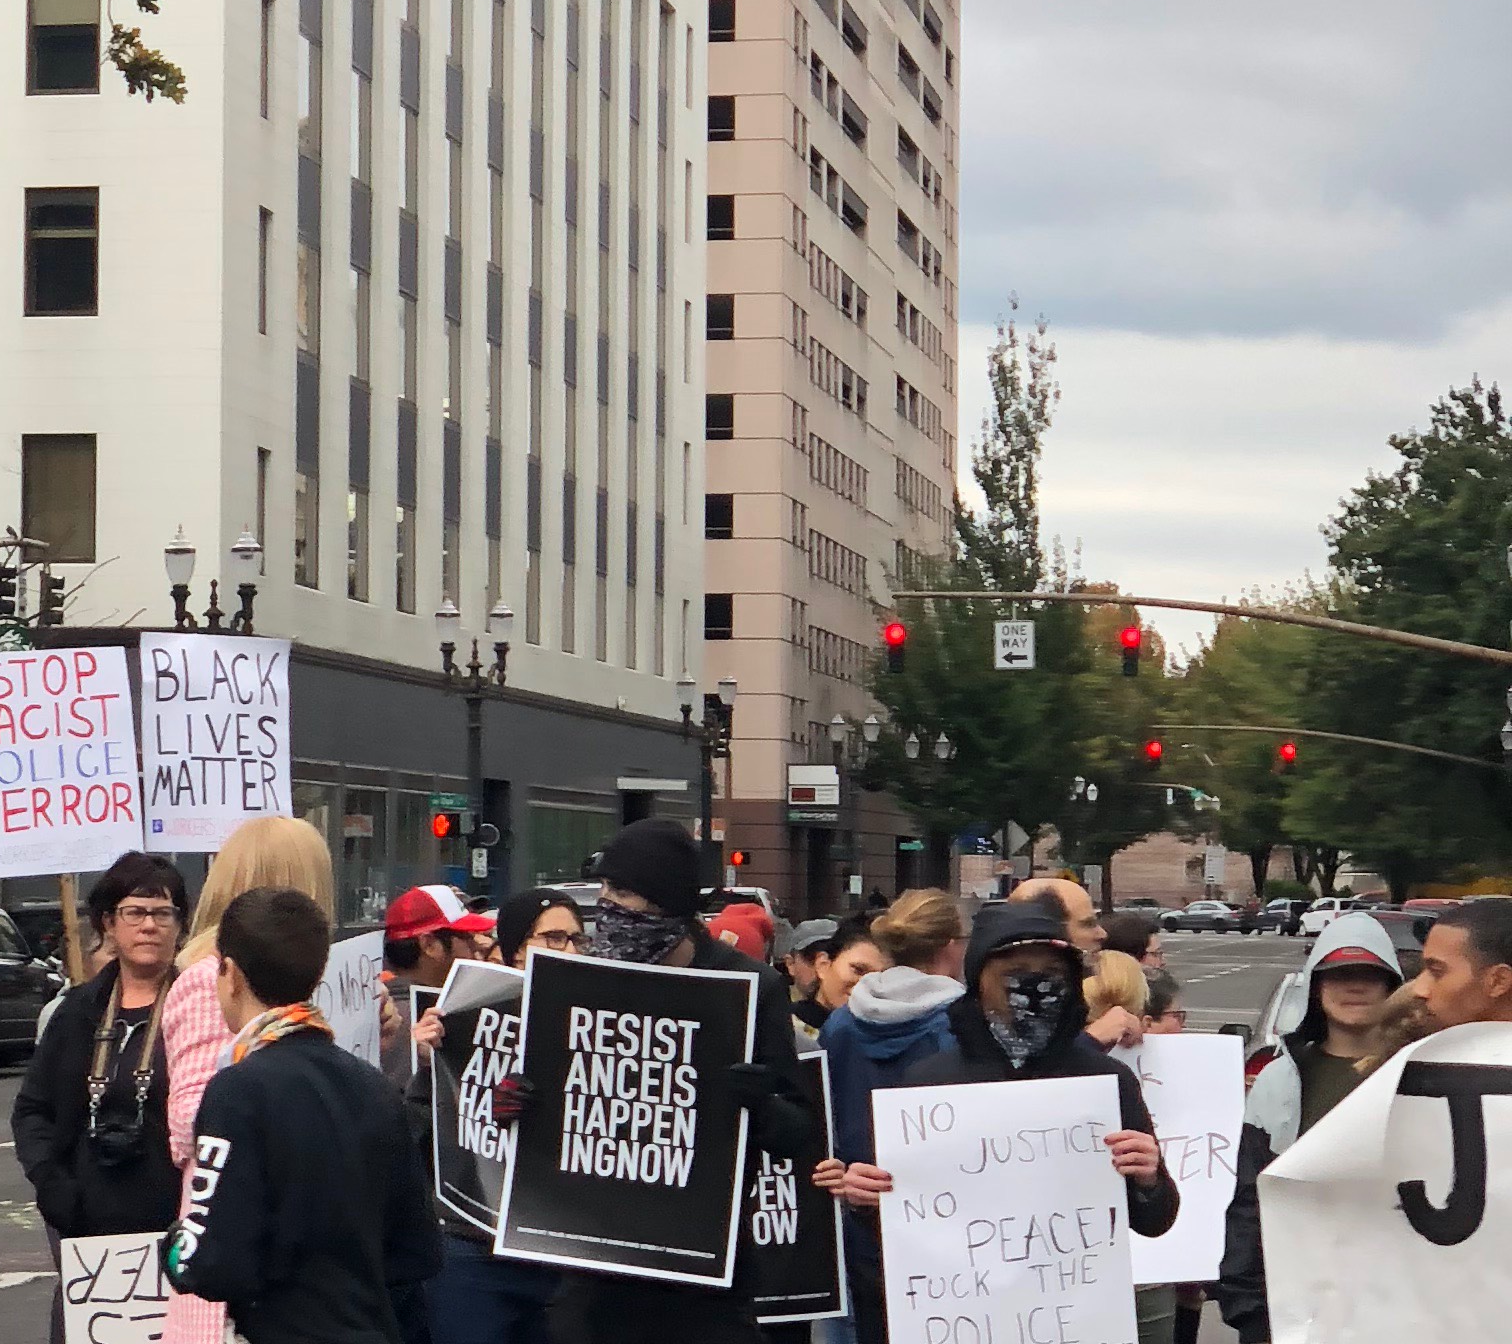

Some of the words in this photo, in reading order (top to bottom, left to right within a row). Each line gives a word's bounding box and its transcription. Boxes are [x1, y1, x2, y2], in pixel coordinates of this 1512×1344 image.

[1001, 625, 1027, 636] ONE
[1001, 638, 1028, 648] WAY
[151, 648, 280, 707] BLACK
[156, 713, 278, 758] LIVES
[151, 756, 281, 811] MATTER
[473, 1007, 521, 1054] RE
[568, 1006, 701, 1064] RESIST
[461, 1047, 521, 1087] AN
[563, 1052, 698, 1107] ANCEIS
[458, 1084, 498, 1125] HA
[563, 1092, 697, 1149] HAPPEN
[900, 1101, 955, 1145] NO
[458, 1116, 513, 1163] INGN
[559, 1132, 695, 1188] INGNOW
[959, 1121, 1107, 1175] JUSTICE
[1159, 1131, 1238, 1182] TER
[751, 1174, 798, 1211] EN
[903, 1191, 958, 1223] NO
[752, 1209, 799, 1246] OW
[965, 1206, 1117, 1267] PEACE!
[66, 1238, 170, 1305] TER
[905, 1269, 991, 1310] FUCK
[1028, 1254, 1099, 1293] THE
